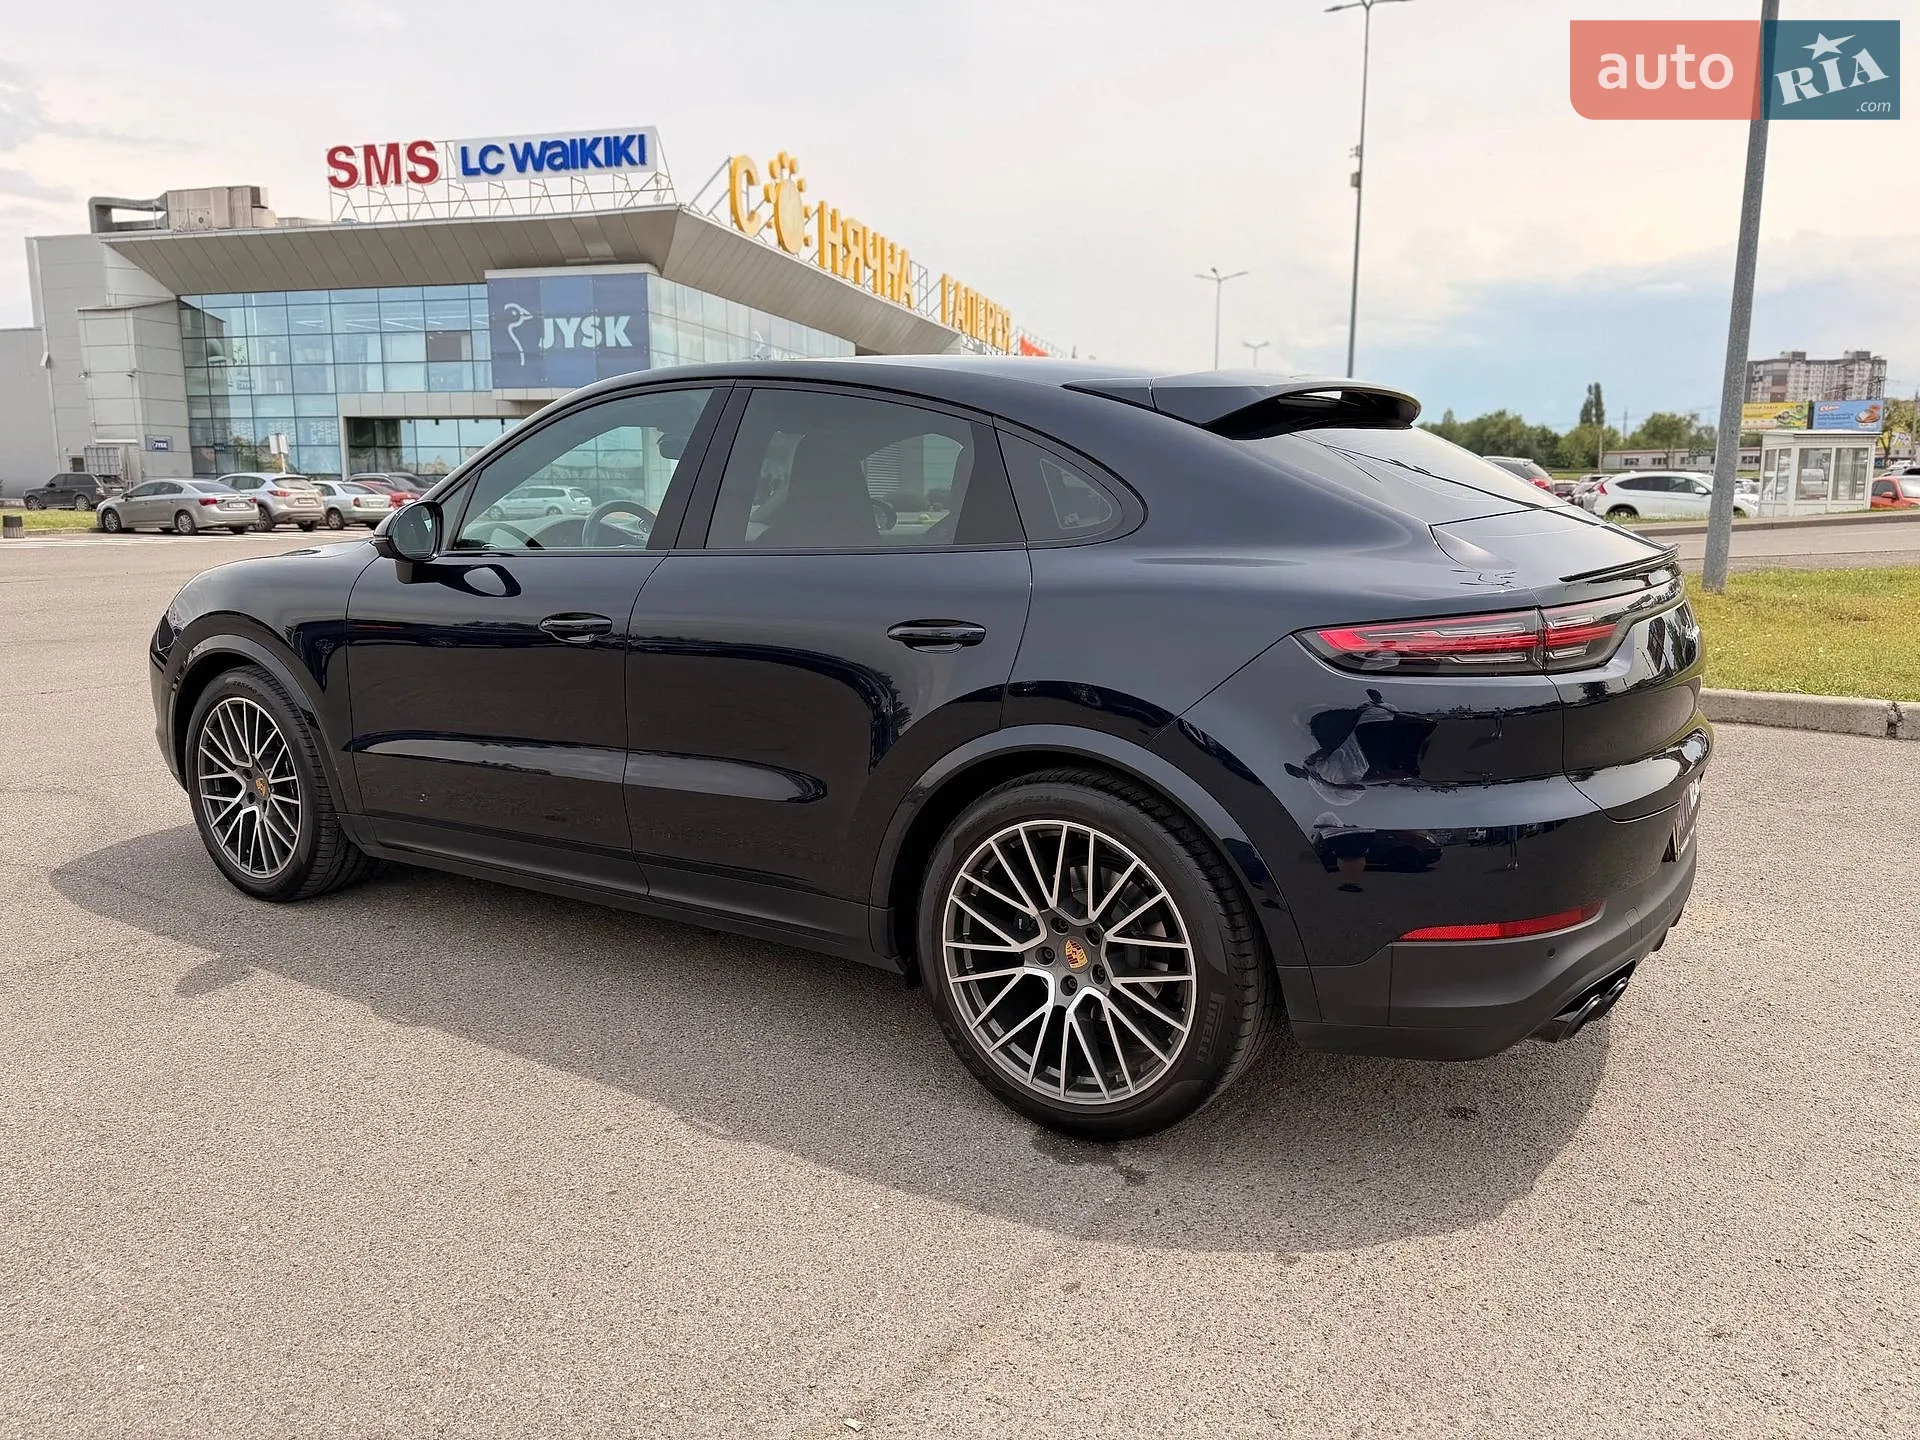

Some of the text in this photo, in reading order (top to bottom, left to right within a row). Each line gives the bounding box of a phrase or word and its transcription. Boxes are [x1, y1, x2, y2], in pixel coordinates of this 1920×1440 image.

[326, 140, 442, 190] SMS
[460, 144, 506, 177] LC
[538, 315, 633, 349] JYSK
